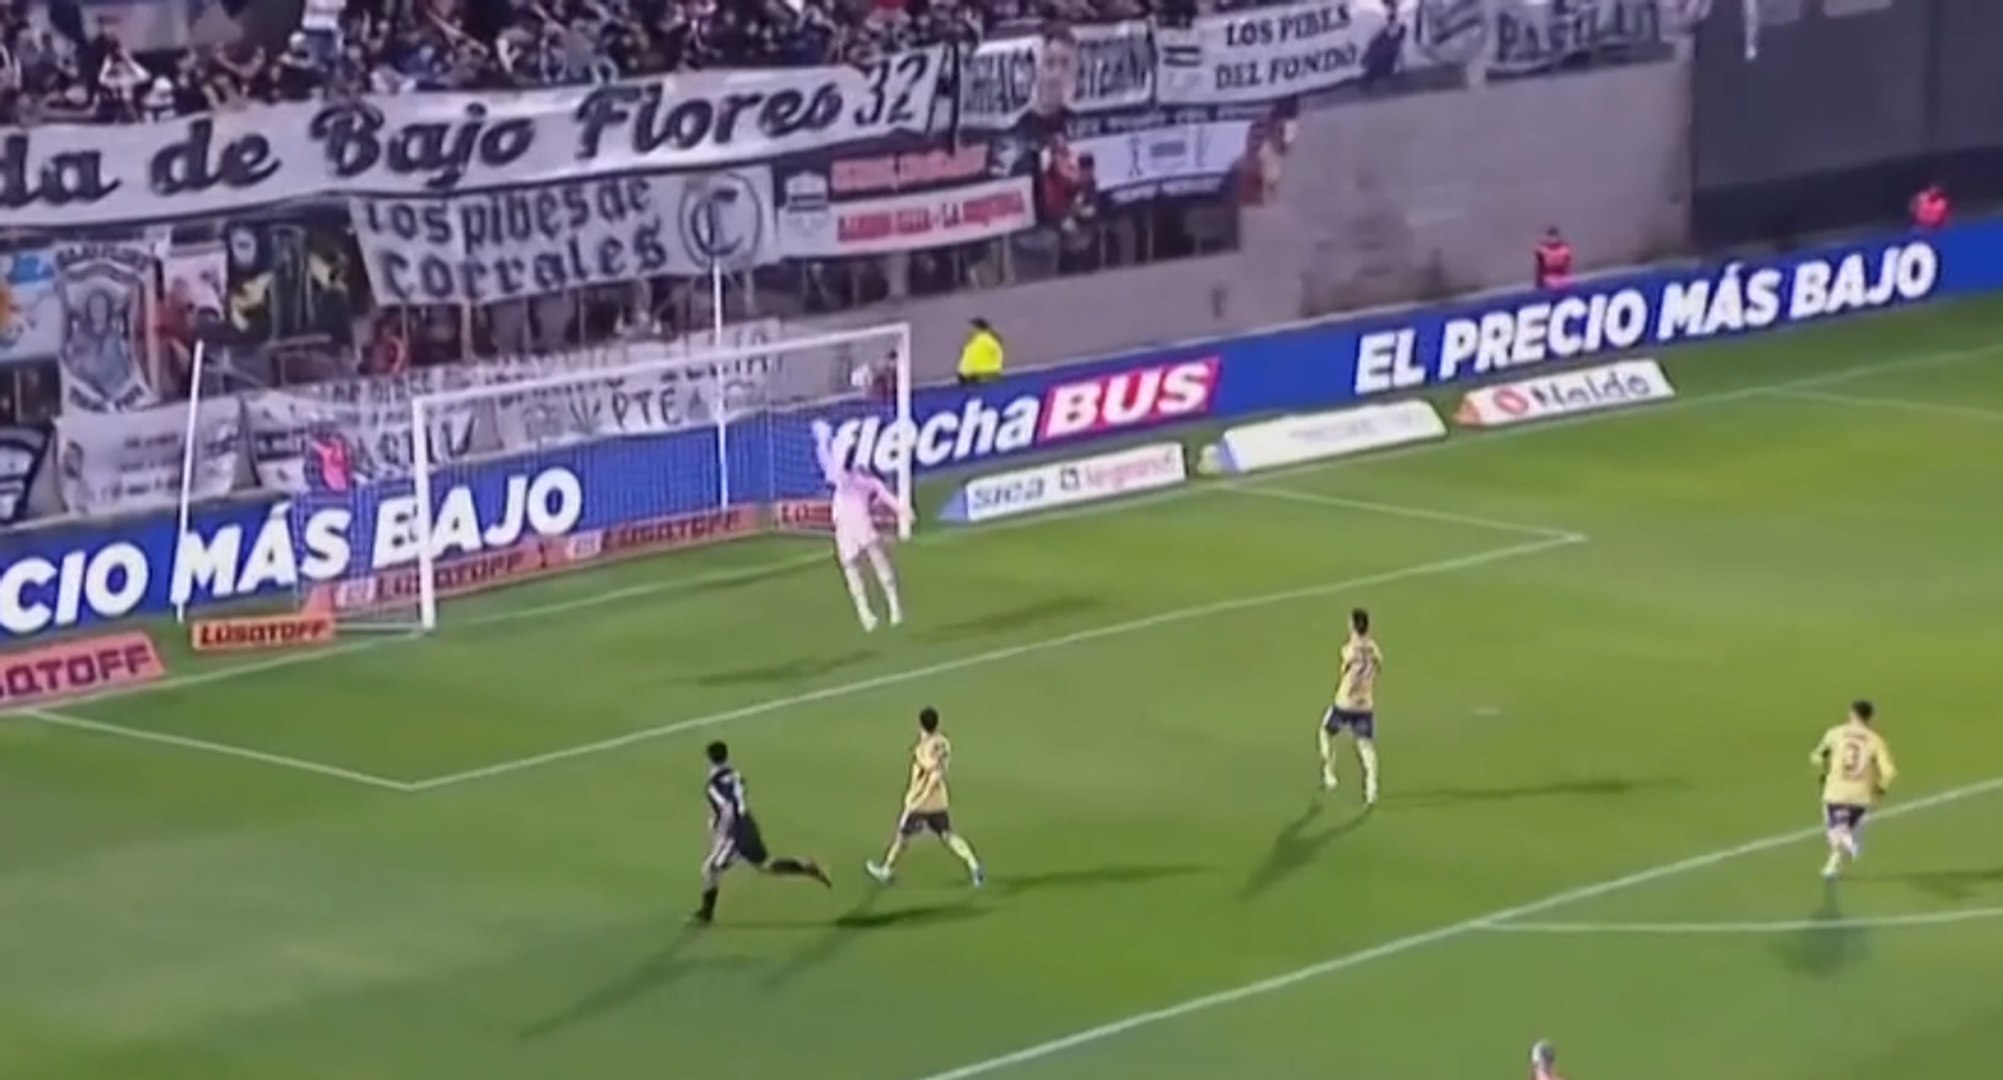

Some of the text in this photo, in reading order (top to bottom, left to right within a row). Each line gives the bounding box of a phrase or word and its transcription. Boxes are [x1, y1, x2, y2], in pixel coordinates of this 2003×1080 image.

[1215, 61, 1261, 89] DEL
[1225, 20, 1273, 47] LOS
[150, 118, 282, 195] de
[310, 102, 536, 188] Bajo
[574, 82, 843, 160] Flores
[855, 53, 929, 127] 32
[1355, 241, 1937, 395] EL PRECIO MÁS BAJO
[0, 466, 583, 634] CIO MÁS BAJO
